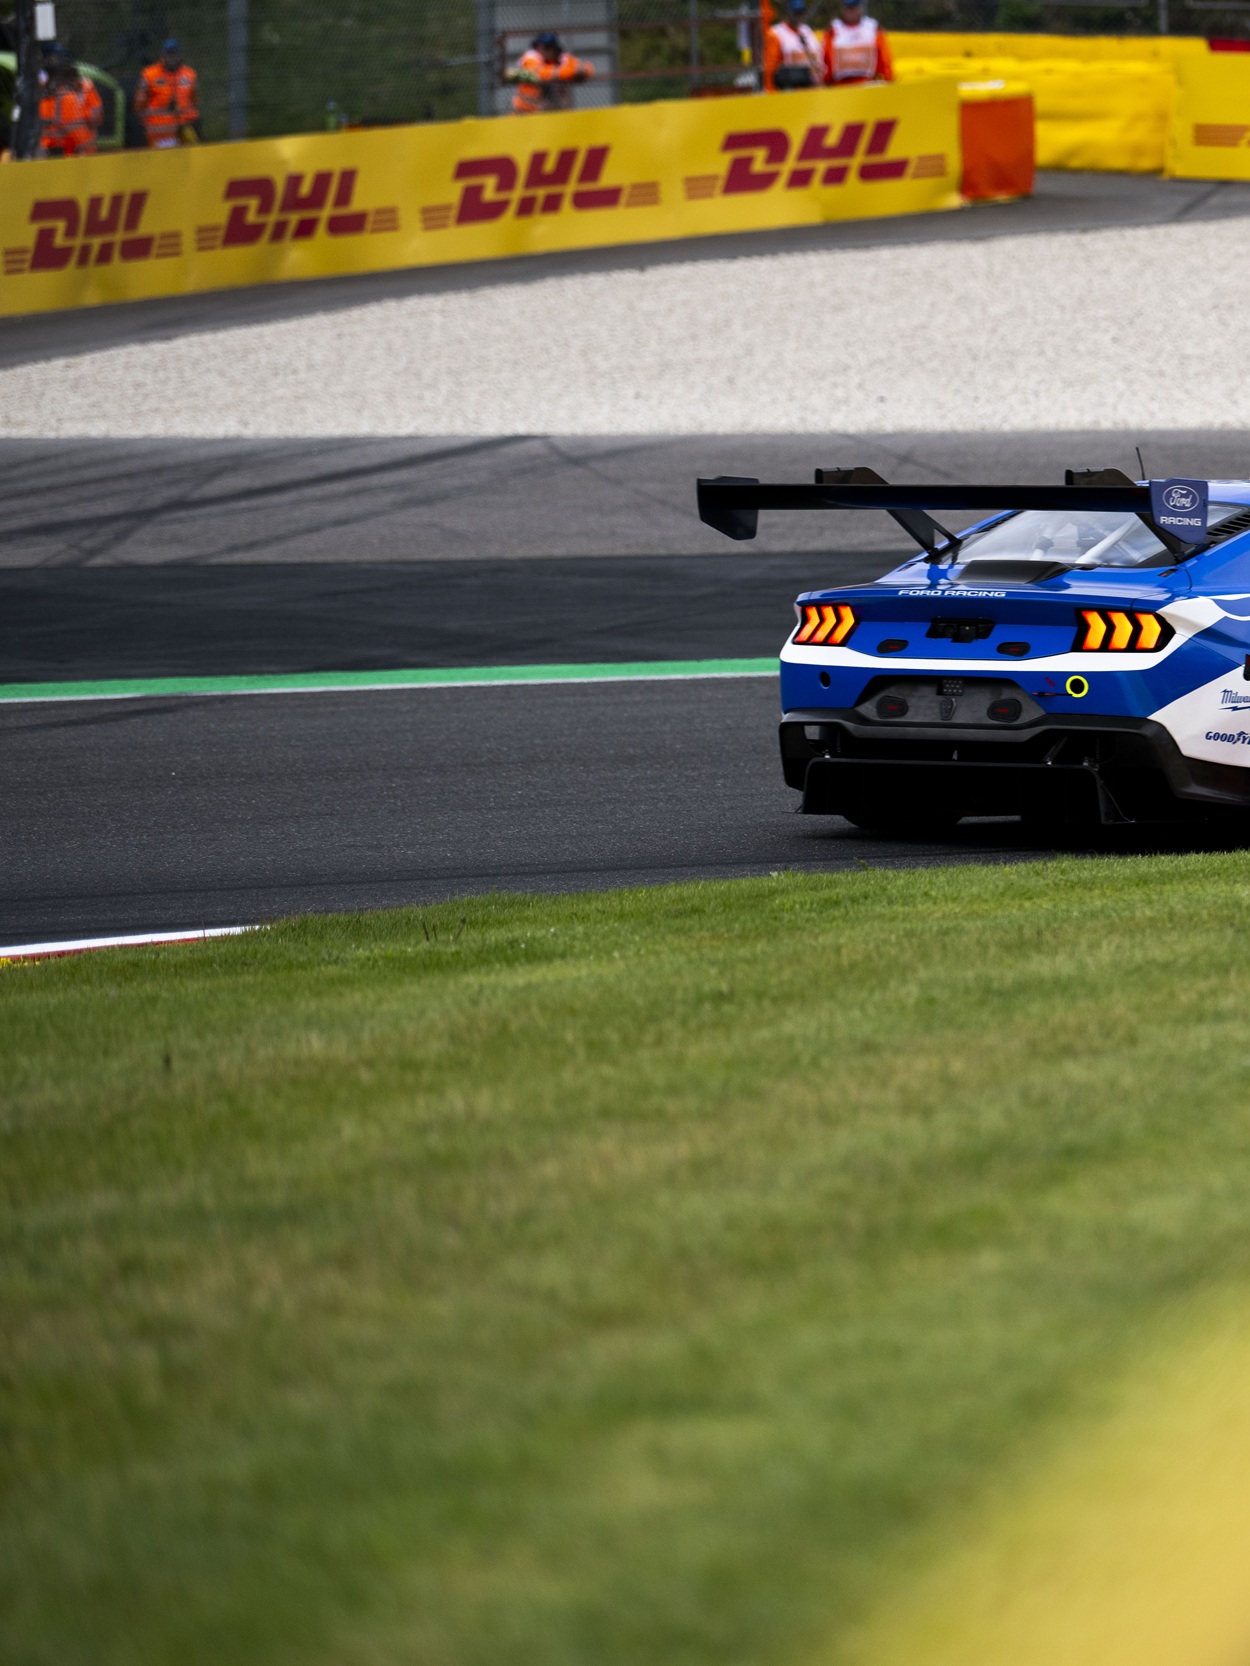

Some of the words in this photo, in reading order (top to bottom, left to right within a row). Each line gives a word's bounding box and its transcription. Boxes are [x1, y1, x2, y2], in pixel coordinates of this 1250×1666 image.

[453, 145, 623, 225] DHL
[721, 118, 910, 195] DHL
[28, 190, 155, 272] DHL
[221, 168, 368, 248] DHL
[1160, 516, 1202, 526] RACING
[1169, 488, 1193, 508] Ford
[898, 589, 942, 597] FORD
[943, 590, 1007, 598] RACING
